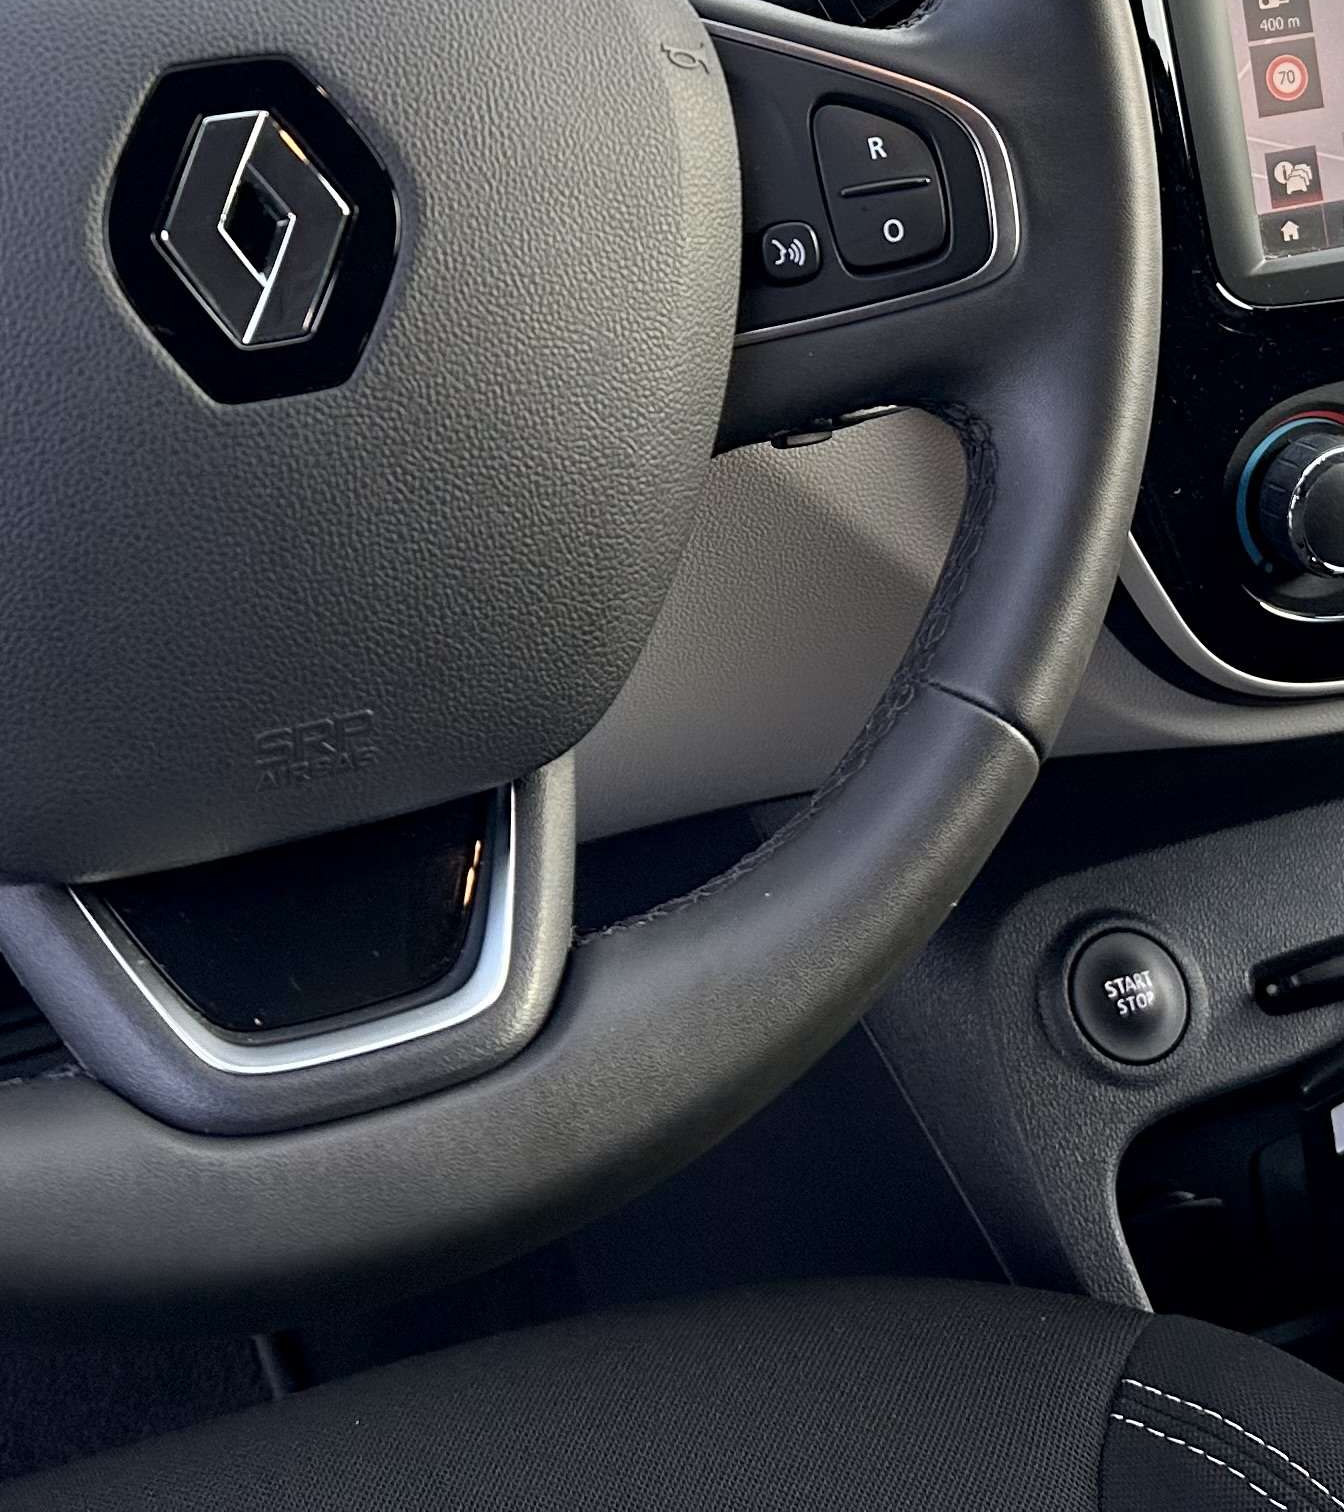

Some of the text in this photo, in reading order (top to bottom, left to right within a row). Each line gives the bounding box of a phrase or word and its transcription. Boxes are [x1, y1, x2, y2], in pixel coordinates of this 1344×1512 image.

[1259, 16, 1301, 32] 400 m
[1278, 69, 1296, 85] 70
[867, 137, 887, 160] R
[1104, 970, 1153, 998] START
[1117, 991, 1154, 1015] STOP
